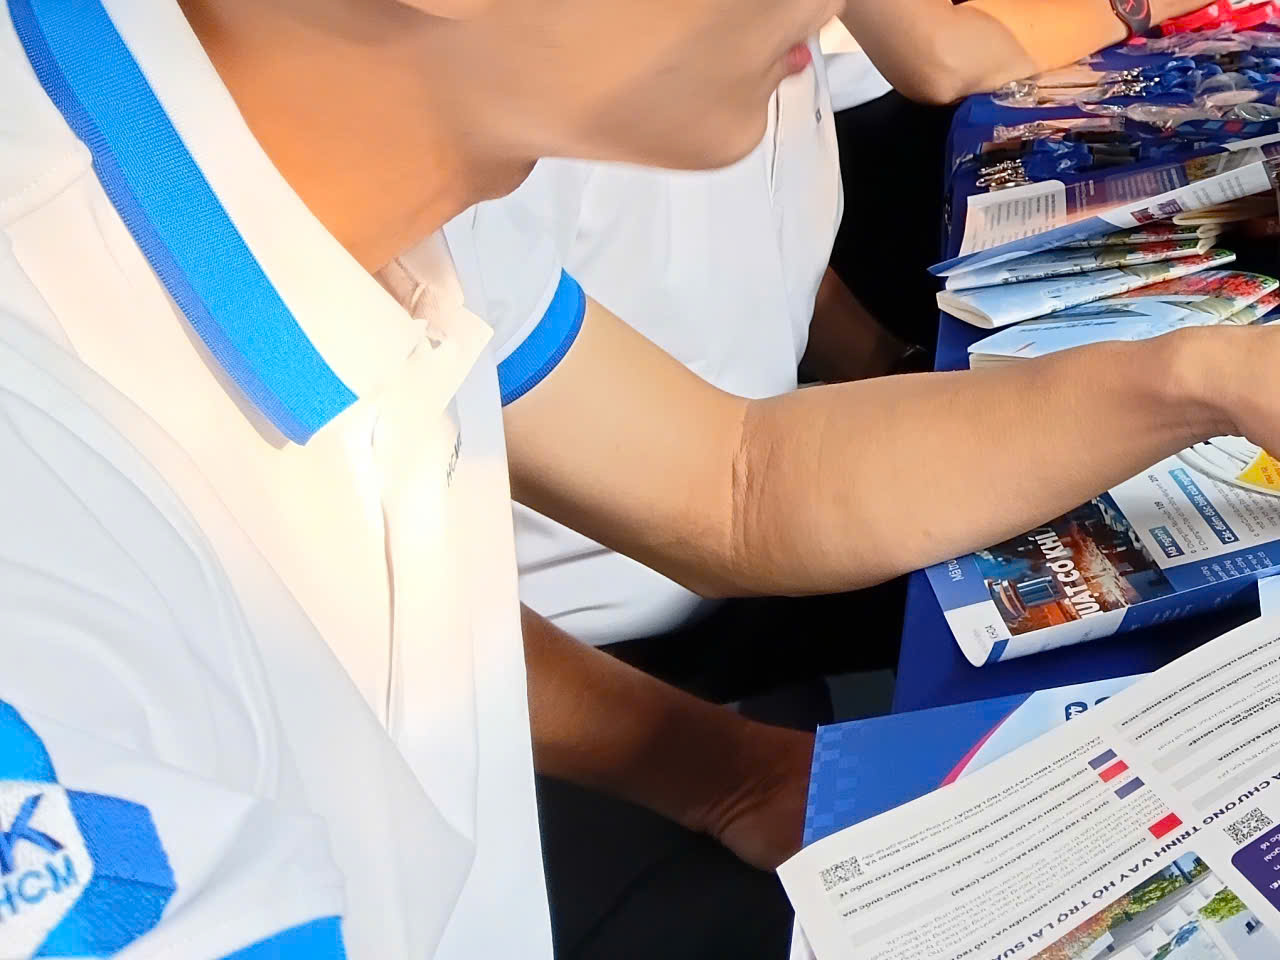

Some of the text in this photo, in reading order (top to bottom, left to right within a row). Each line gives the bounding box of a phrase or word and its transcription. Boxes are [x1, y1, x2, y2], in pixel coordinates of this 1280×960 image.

[1028, 532, 1068, 560] KHÍ
[1046, 559, 1080, 583] CƠ
[1200, 778, 1272, 827] CHƯƠNG
[1152, 824, 1200, 859] TRÌNH
[1117, 853, 1153, 883] VAY
[1054, 897, 1089, 925] TRỢ
